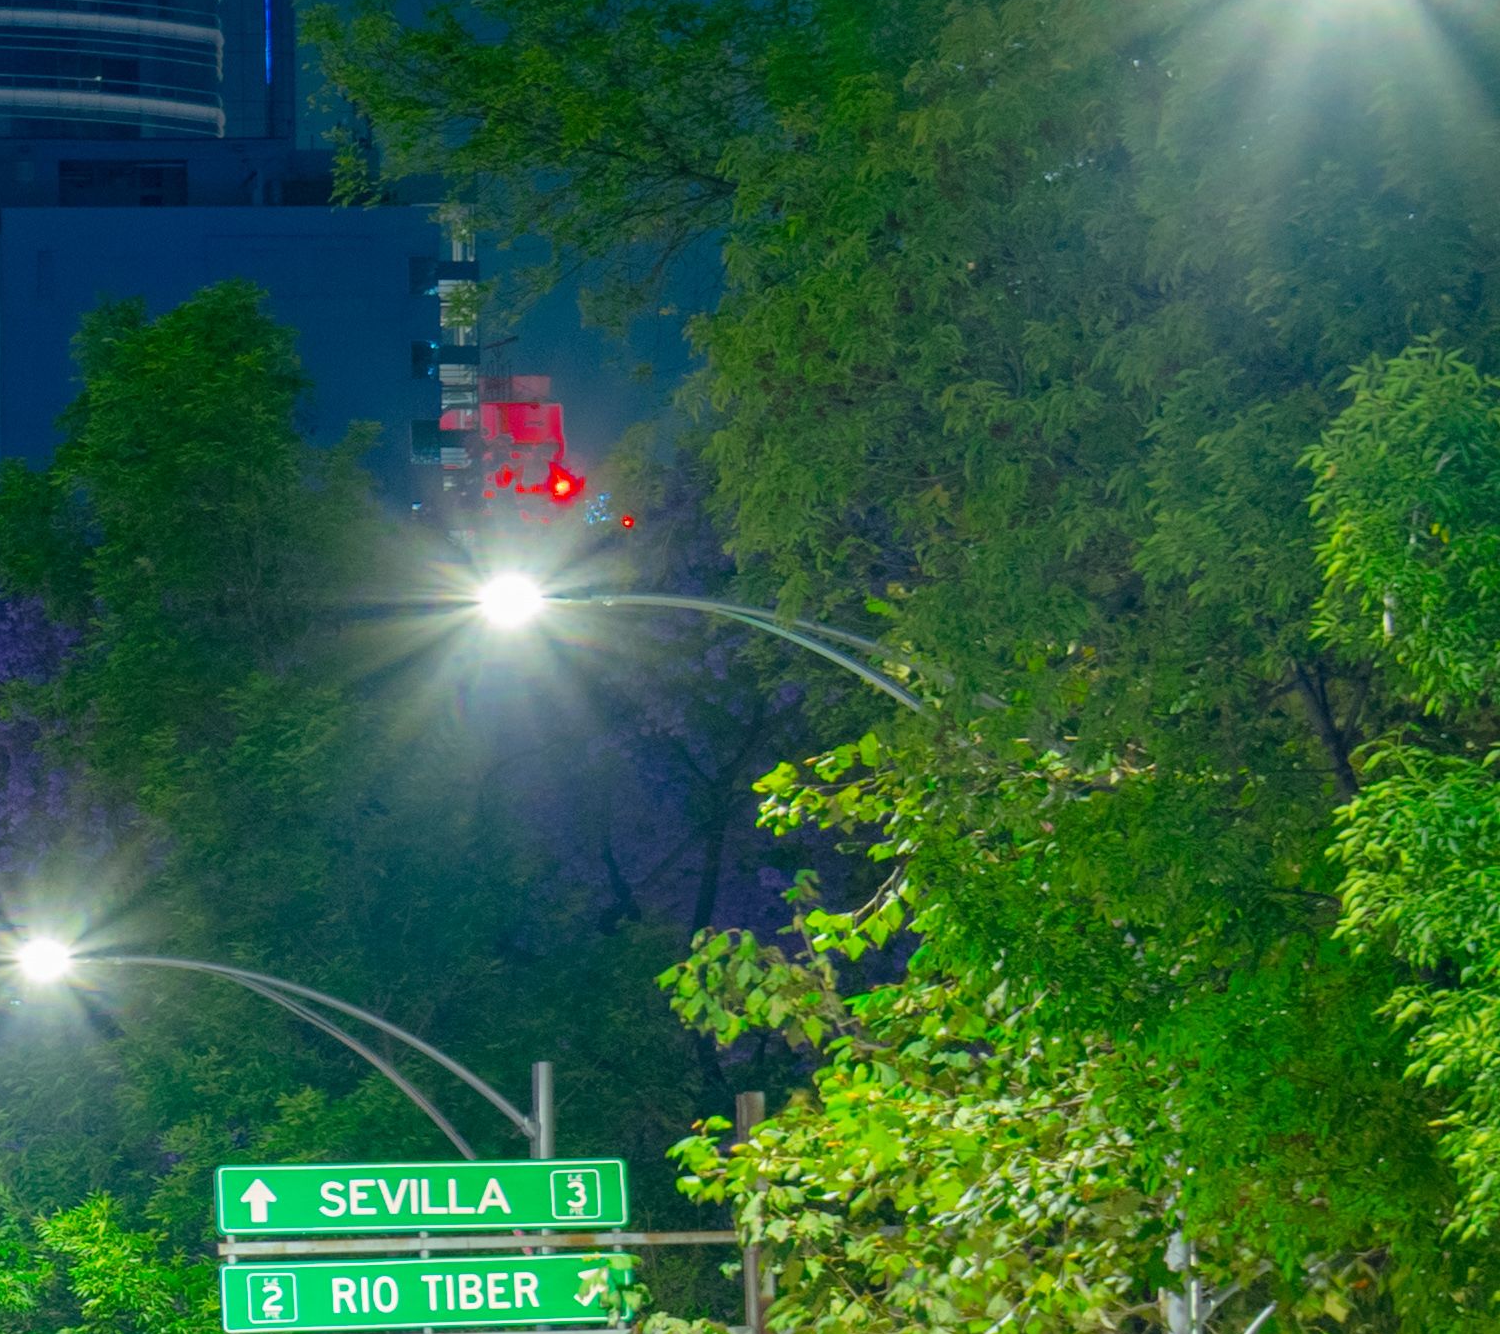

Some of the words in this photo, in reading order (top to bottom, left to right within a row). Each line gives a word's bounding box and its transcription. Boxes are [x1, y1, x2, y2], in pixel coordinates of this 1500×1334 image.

[318, 1178, 512, 1218] SEVILLA
[566, 1181, 587, 1208] 3
[262, 1285, 284, 1312] 2
[331, 1275, 399, 1314] RIO
[420, 1271, 540, 1312] TIBER
